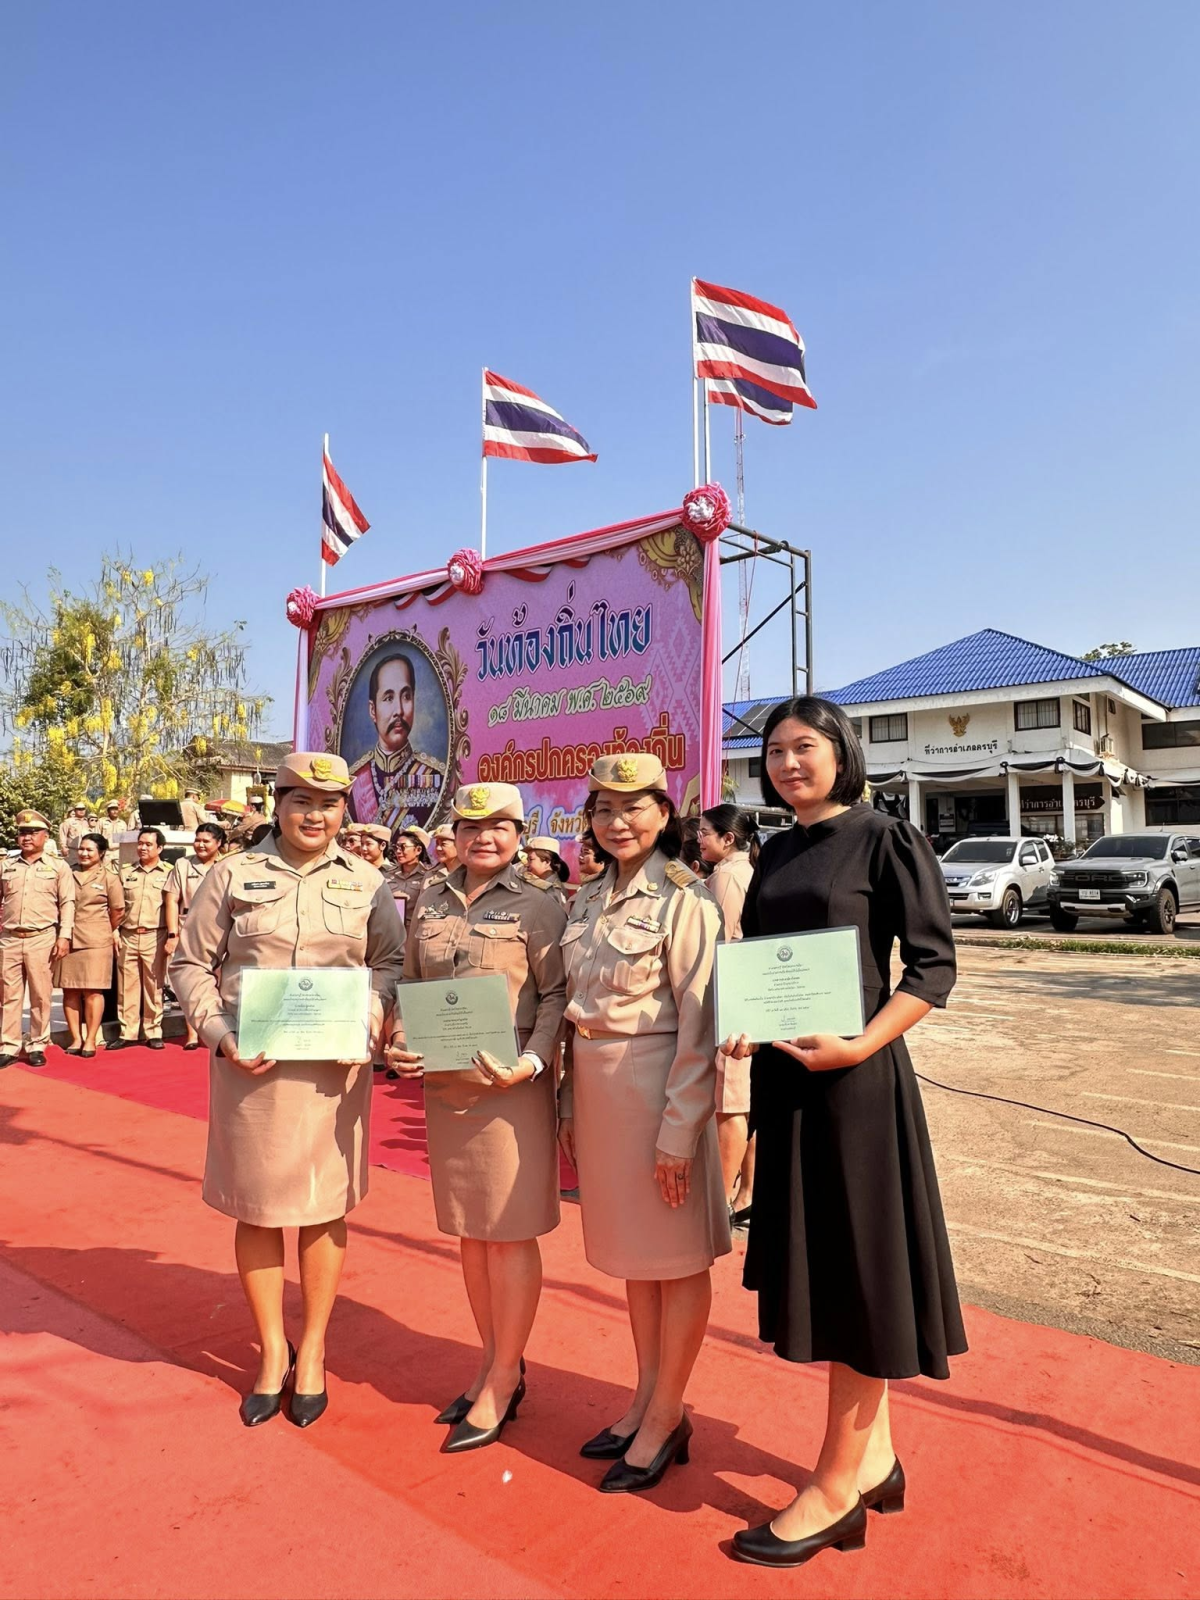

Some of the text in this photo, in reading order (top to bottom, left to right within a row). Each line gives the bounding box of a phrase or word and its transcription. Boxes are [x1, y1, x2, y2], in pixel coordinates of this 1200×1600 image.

[487, 695, 512, 727] ๑๘
[512, 686, 567, 721] มีนาคม
